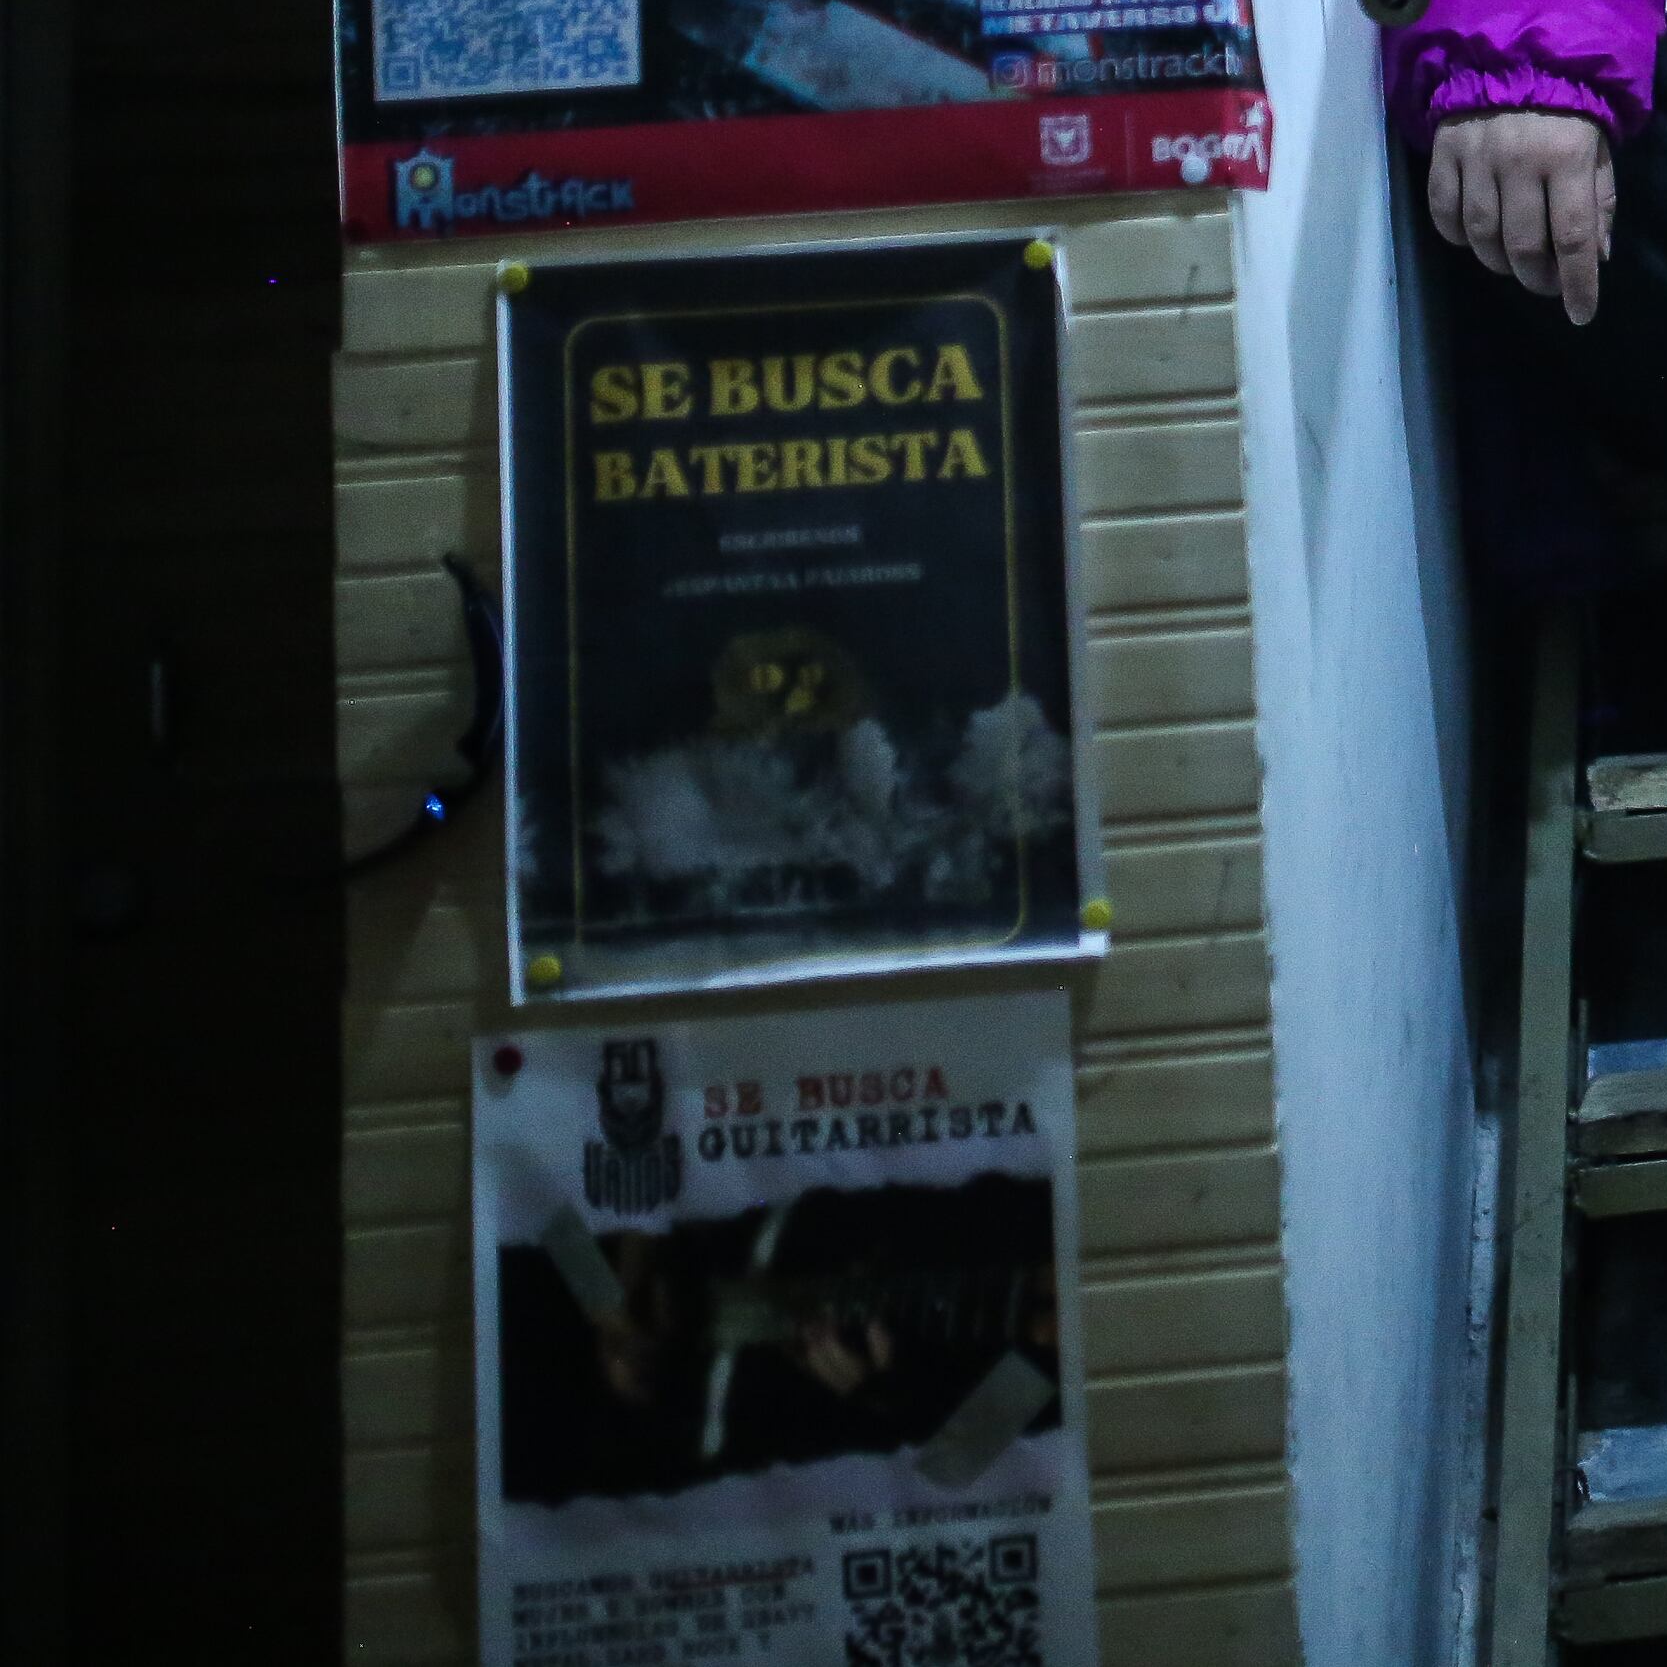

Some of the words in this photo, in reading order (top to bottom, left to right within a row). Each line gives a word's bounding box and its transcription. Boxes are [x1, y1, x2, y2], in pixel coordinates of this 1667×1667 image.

[589, 362, 695, 425] SE
[707, 342, 984, 417] BUSCA
[593, 428, 989, 503] BATERISTA
[703, 1081, 762, 1120] SE
[795, 1065, 950, 1114] BUSCA
[698, 1100, 1037, 1163] GUITARRISTA
